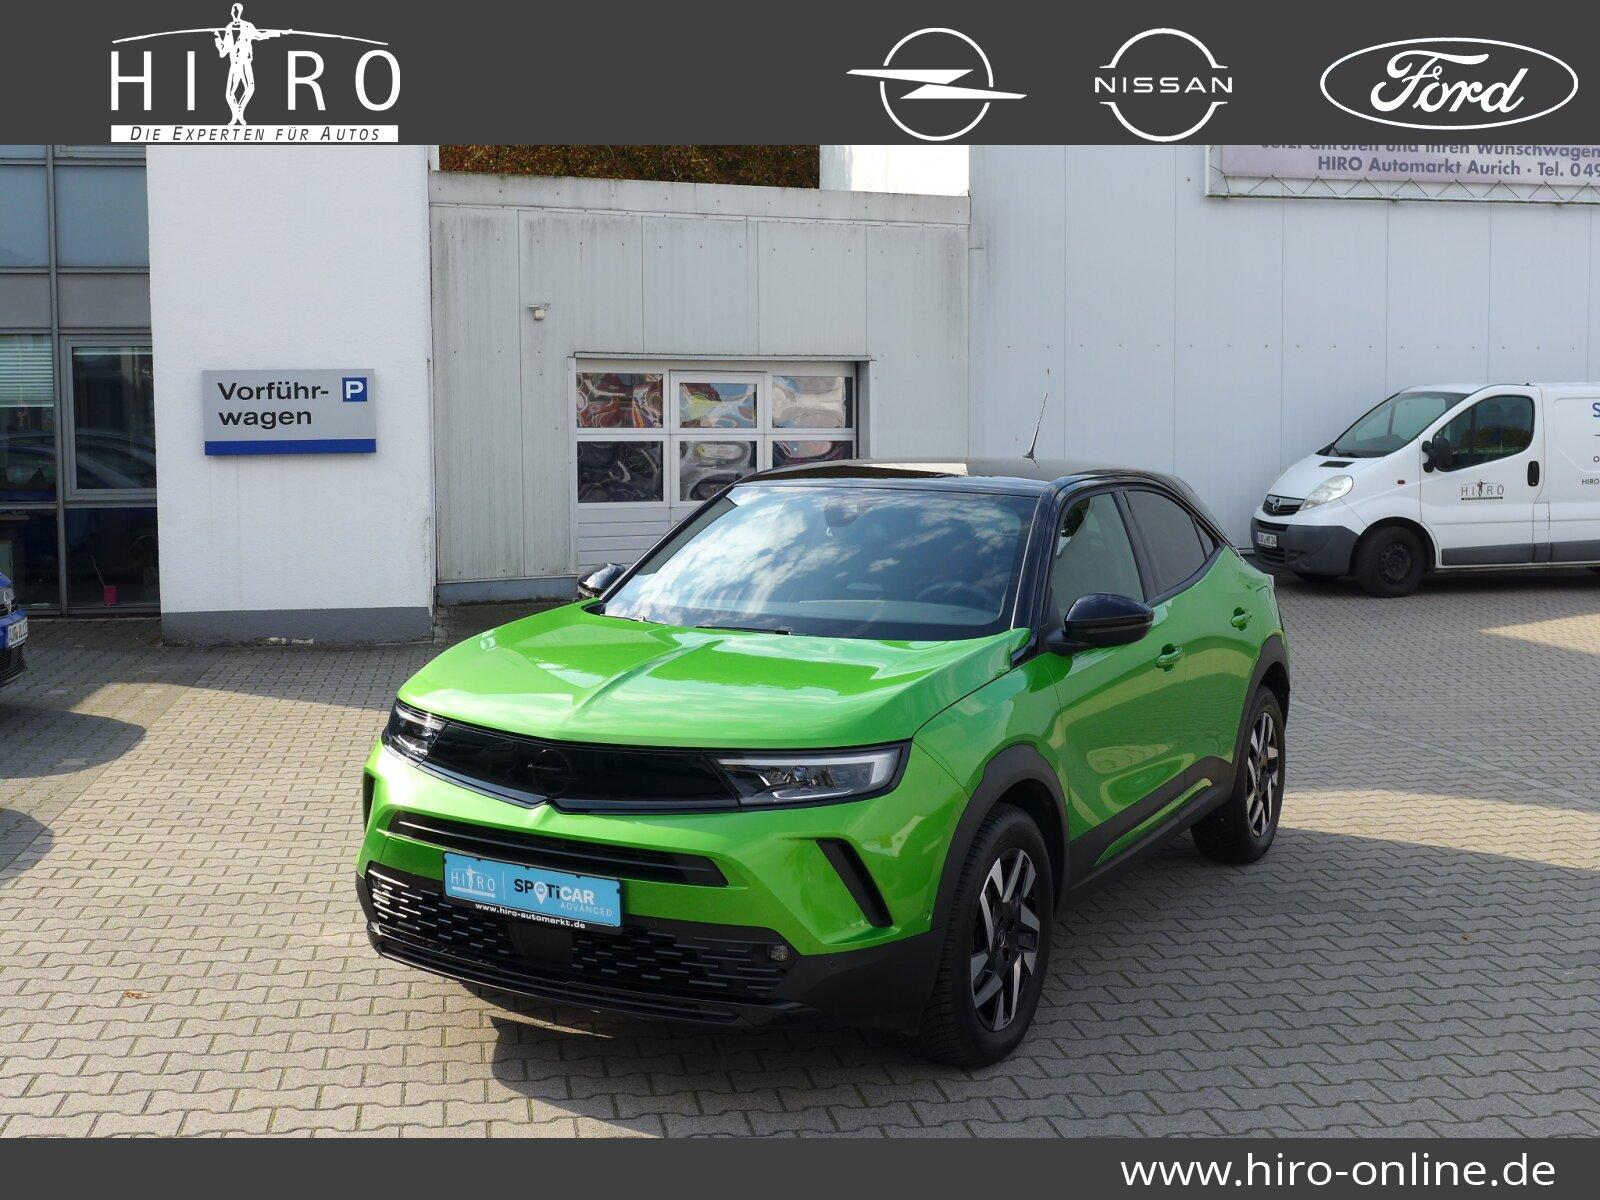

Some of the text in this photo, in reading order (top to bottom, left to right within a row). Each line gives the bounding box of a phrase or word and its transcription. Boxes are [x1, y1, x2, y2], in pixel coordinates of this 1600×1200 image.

[1318, 156, 1362, 171] HIRO
[1368, 157, 1461, 173] Automarkt
[1467, 160, 1520, 175] Aurich
[1537, 161, 1564, 177] Tel.
[217, 381, 329, 401] Vorführ-
[345, 380, 364, 399] P
[218, 408, 312, 430] wagen
[1461, 485, 1504, 496] HIRO
[451, 871, 496, 892] HIRO
[475, 902, 586, 929] www.hiro-automarkt.de
[560, 902, 613, 918] ADVANCED
